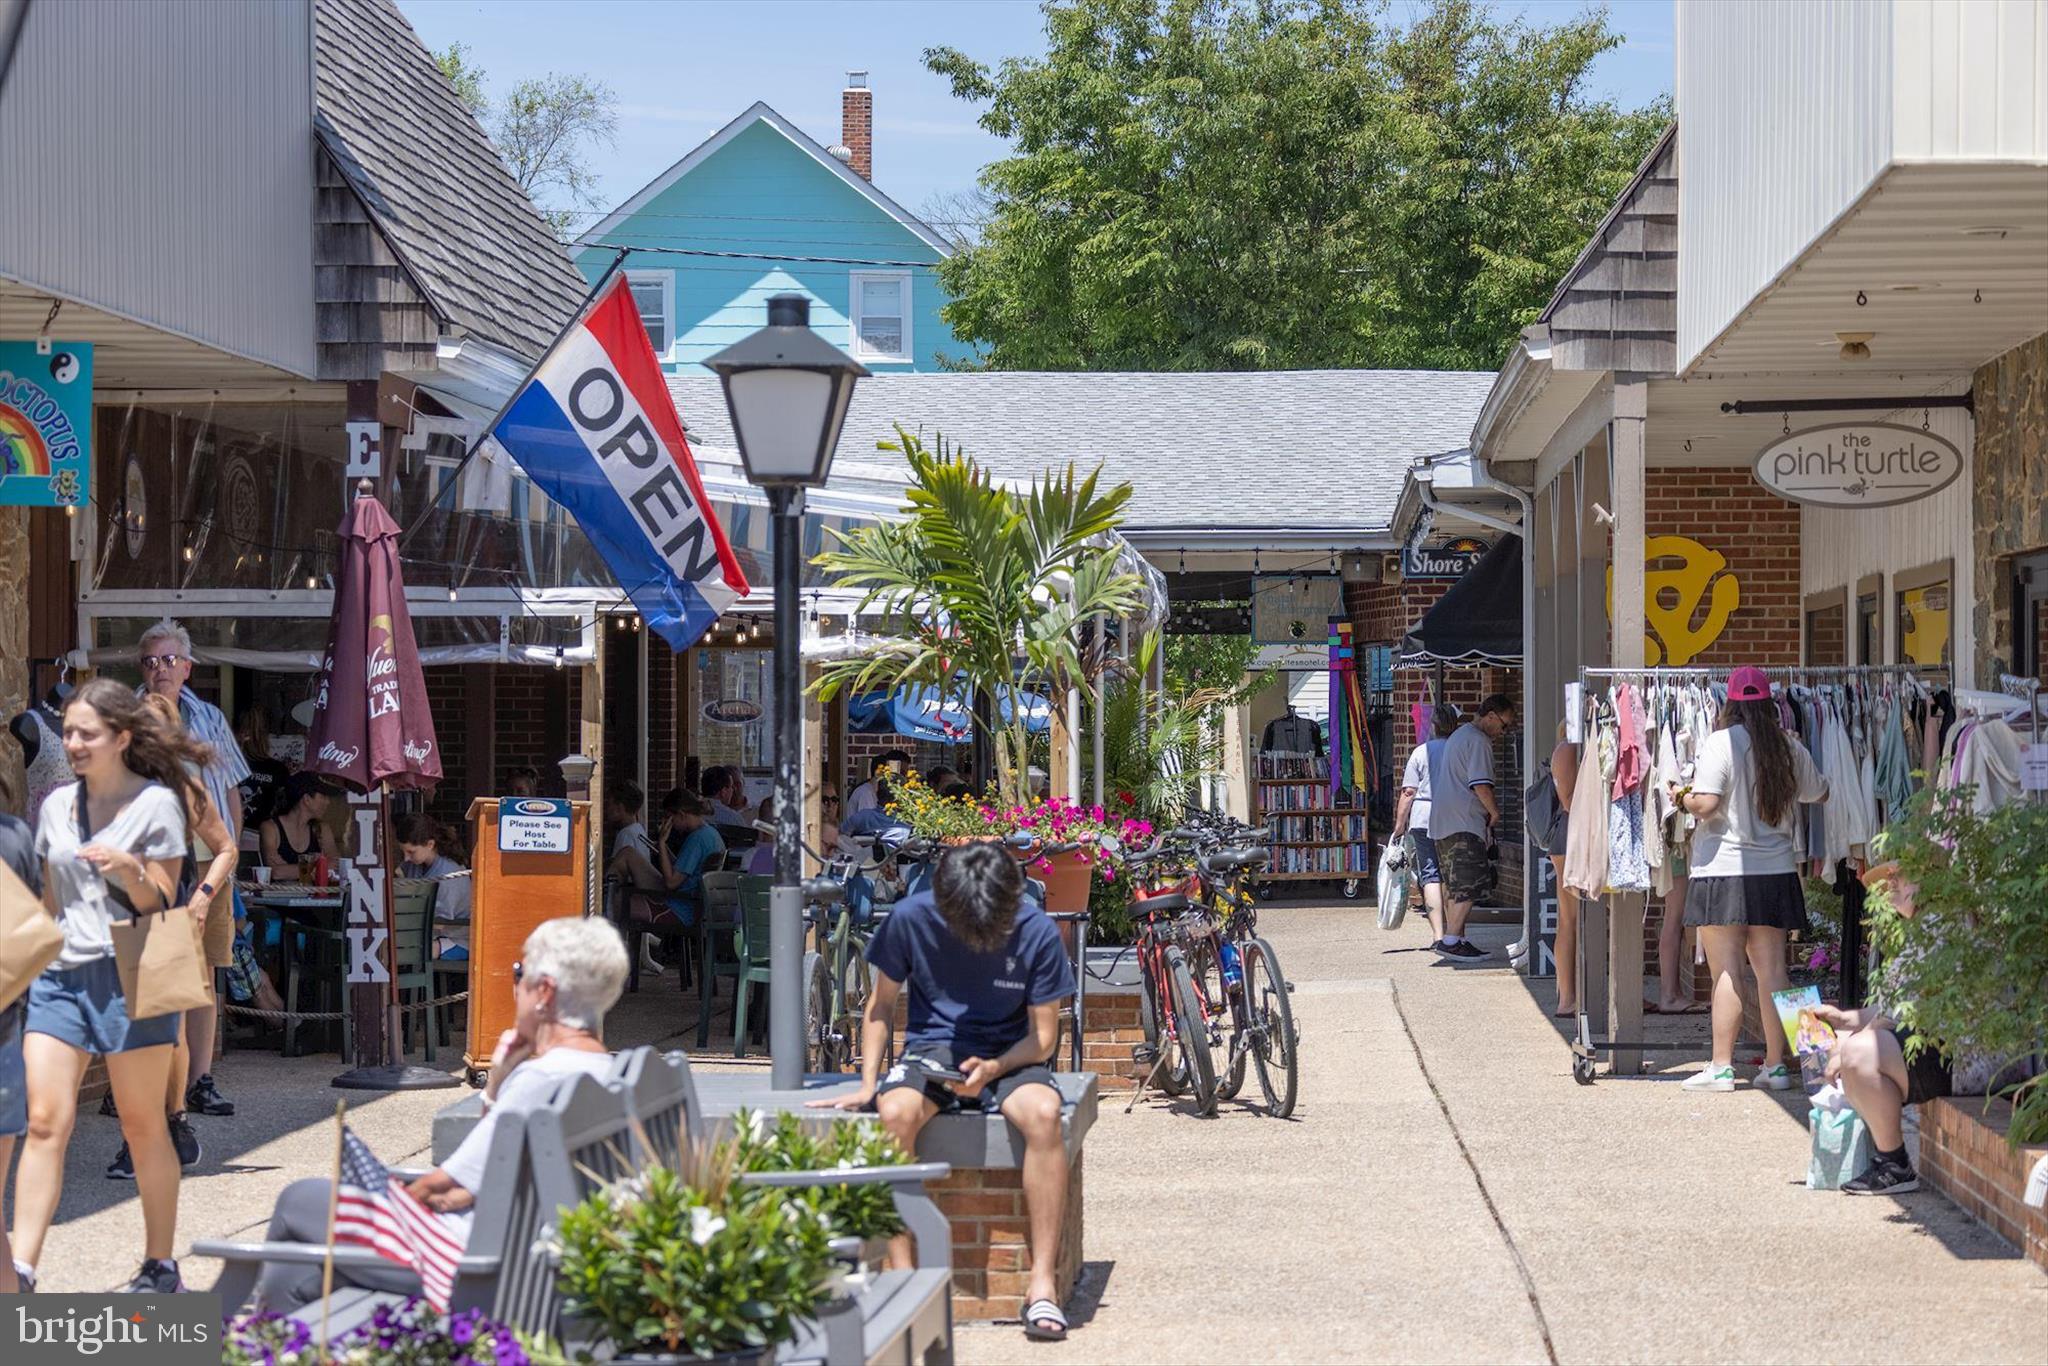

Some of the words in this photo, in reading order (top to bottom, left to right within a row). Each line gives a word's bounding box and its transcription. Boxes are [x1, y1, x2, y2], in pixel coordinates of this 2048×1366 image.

[1843, 433, 1871, 447] the
[1774, 444, 1846, 484] pink
[1855, 443, 1941, 475] turtle
[569, 367, 720, 581] OPEN
[1411, 552, 1463, 574] Shore
[509, 819, 541, 829] Please
[543, 820, 562, 829] See
[524, 830, 547, 838] Host
[513, 840, 530, 848] For
[532, 840, 557, 849] Table
